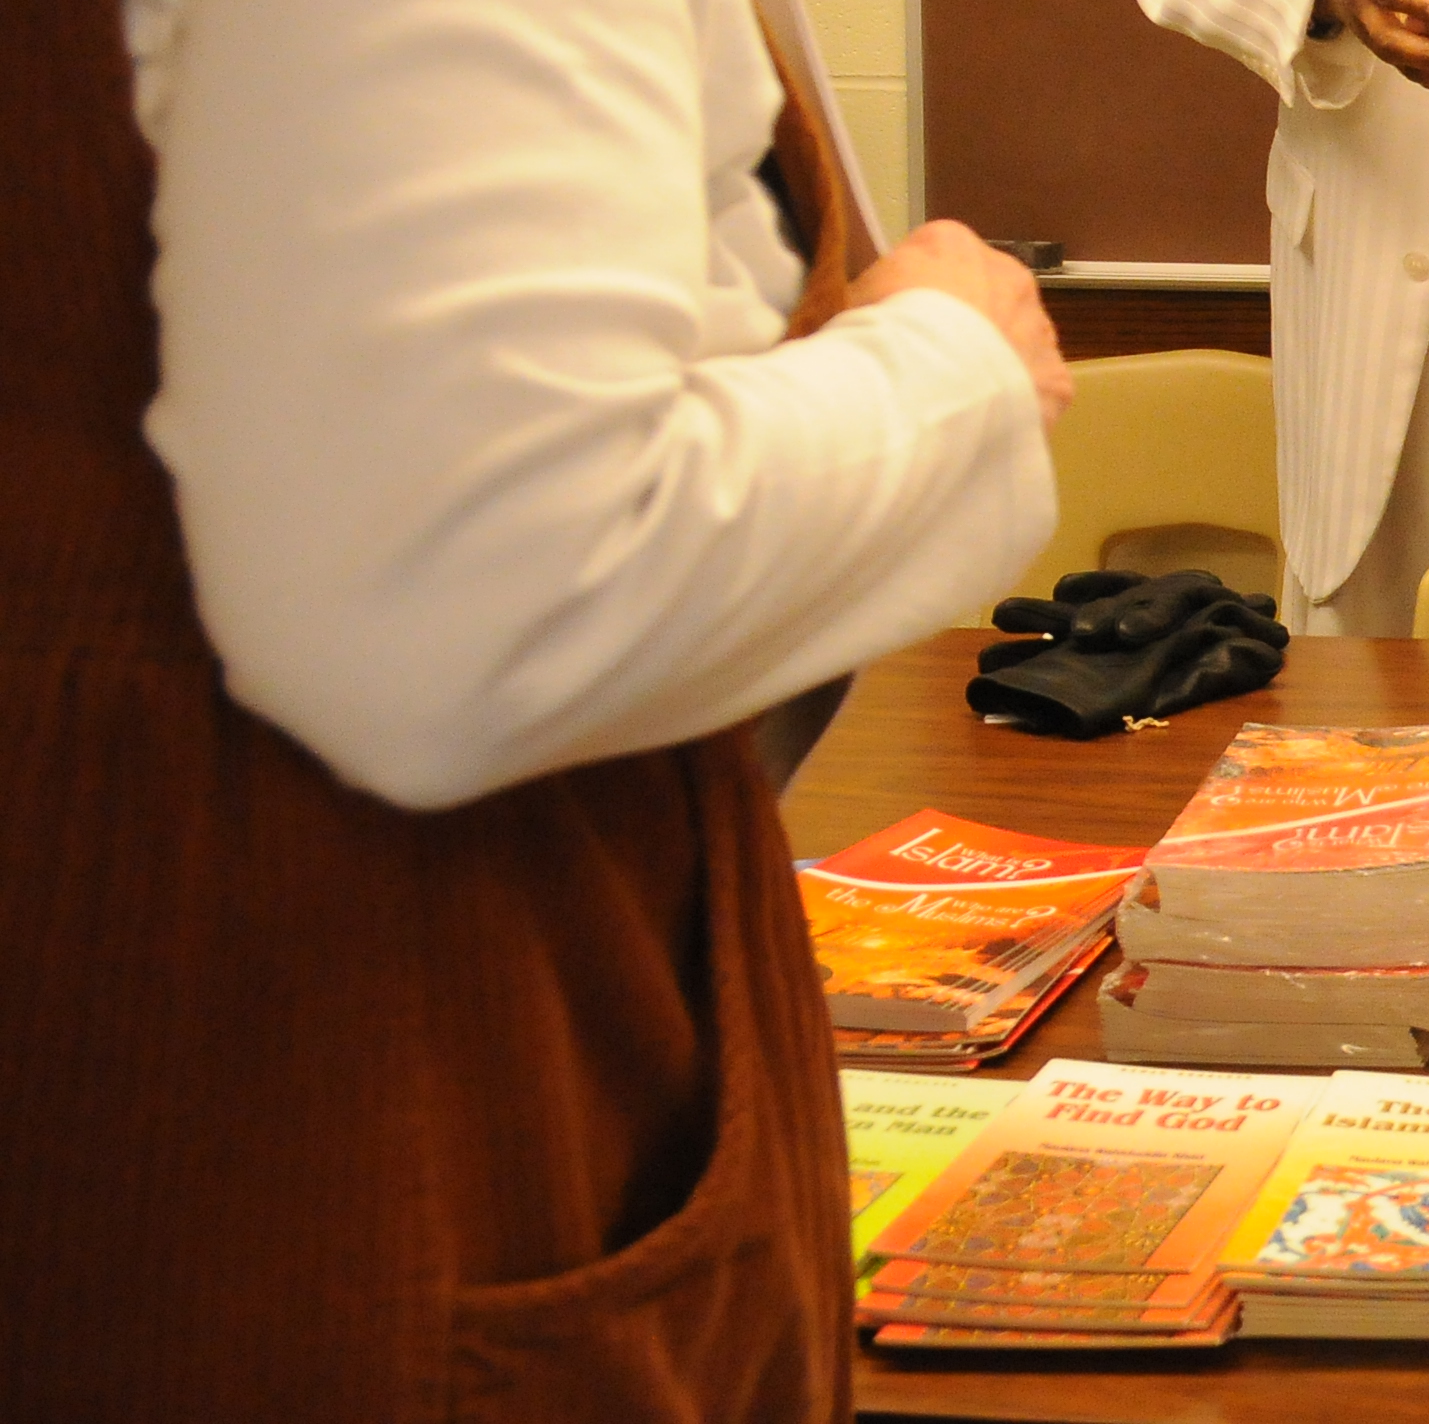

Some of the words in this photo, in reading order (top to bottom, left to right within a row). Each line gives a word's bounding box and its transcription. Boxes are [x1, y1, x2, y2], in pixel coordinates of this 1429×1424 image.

[889, 828, 1053, 880] Islam?
[825, 887, 871, 908] the
[873, 893, 1058, 929] Muslims?
[931, 1106, 991, 1120] the
[1048, 1080, 1123, 1104] The
[1138, 1088, 1224, 1114] Way
[1235, 1093, 1282, 1112] to
[885, 1120, 958, 1136] Man
[1045, 1102, 1145, 1127] Find
[1155, 1111, 1248, 1132] God
